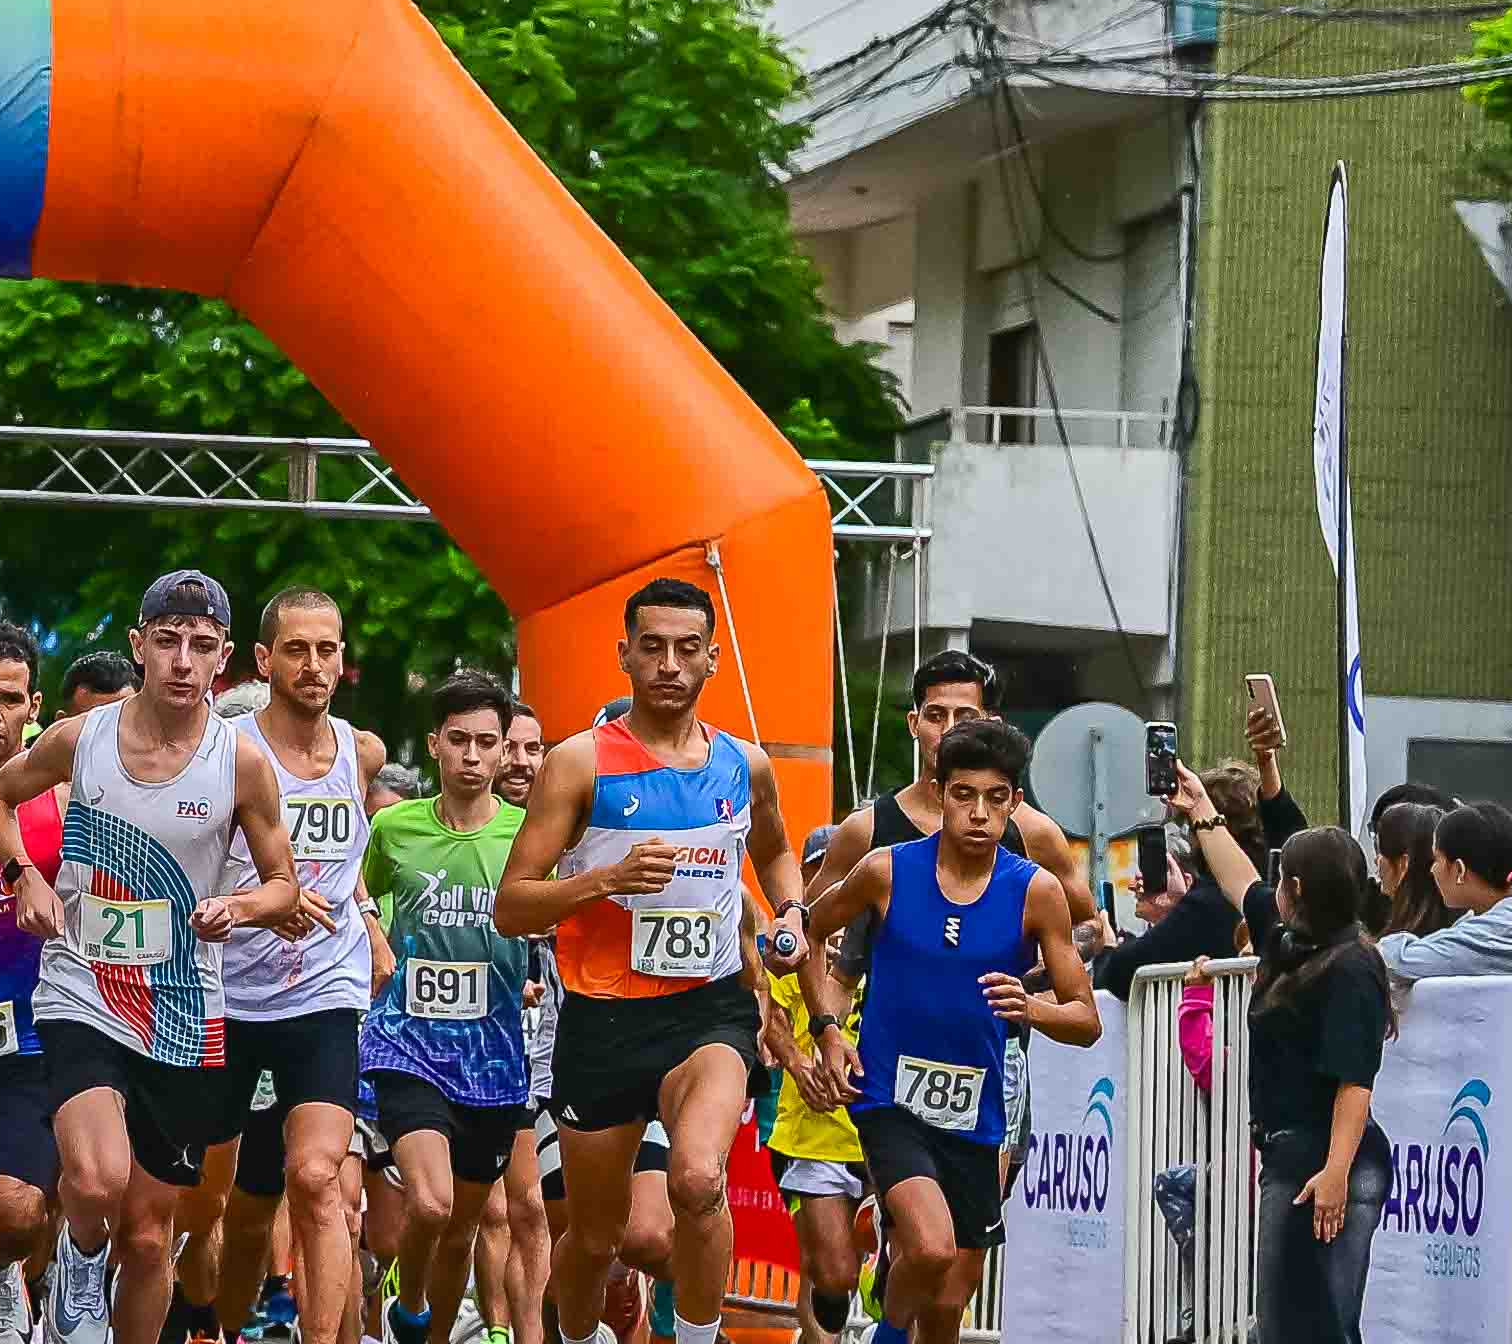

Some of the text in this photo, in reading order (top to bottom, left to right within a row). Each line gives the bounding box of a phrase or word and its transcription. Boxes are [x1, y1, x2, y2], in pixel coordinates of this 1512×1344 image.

[177, 800, 209, 816] FAC
[287, 803, 350, 843] 790
[102, 907, 144, 948] 21
[640, 916, 711, 959] 783
[415, 966, 477, 1004] 691
[904, 1064, 974, 1113] 785
[1024, 1132, 1110, 1213] CARUSO
[1383, 1142, 1484, 1236] ARUSO
[1425, 1242, 1481, 1279] SEGUROS
